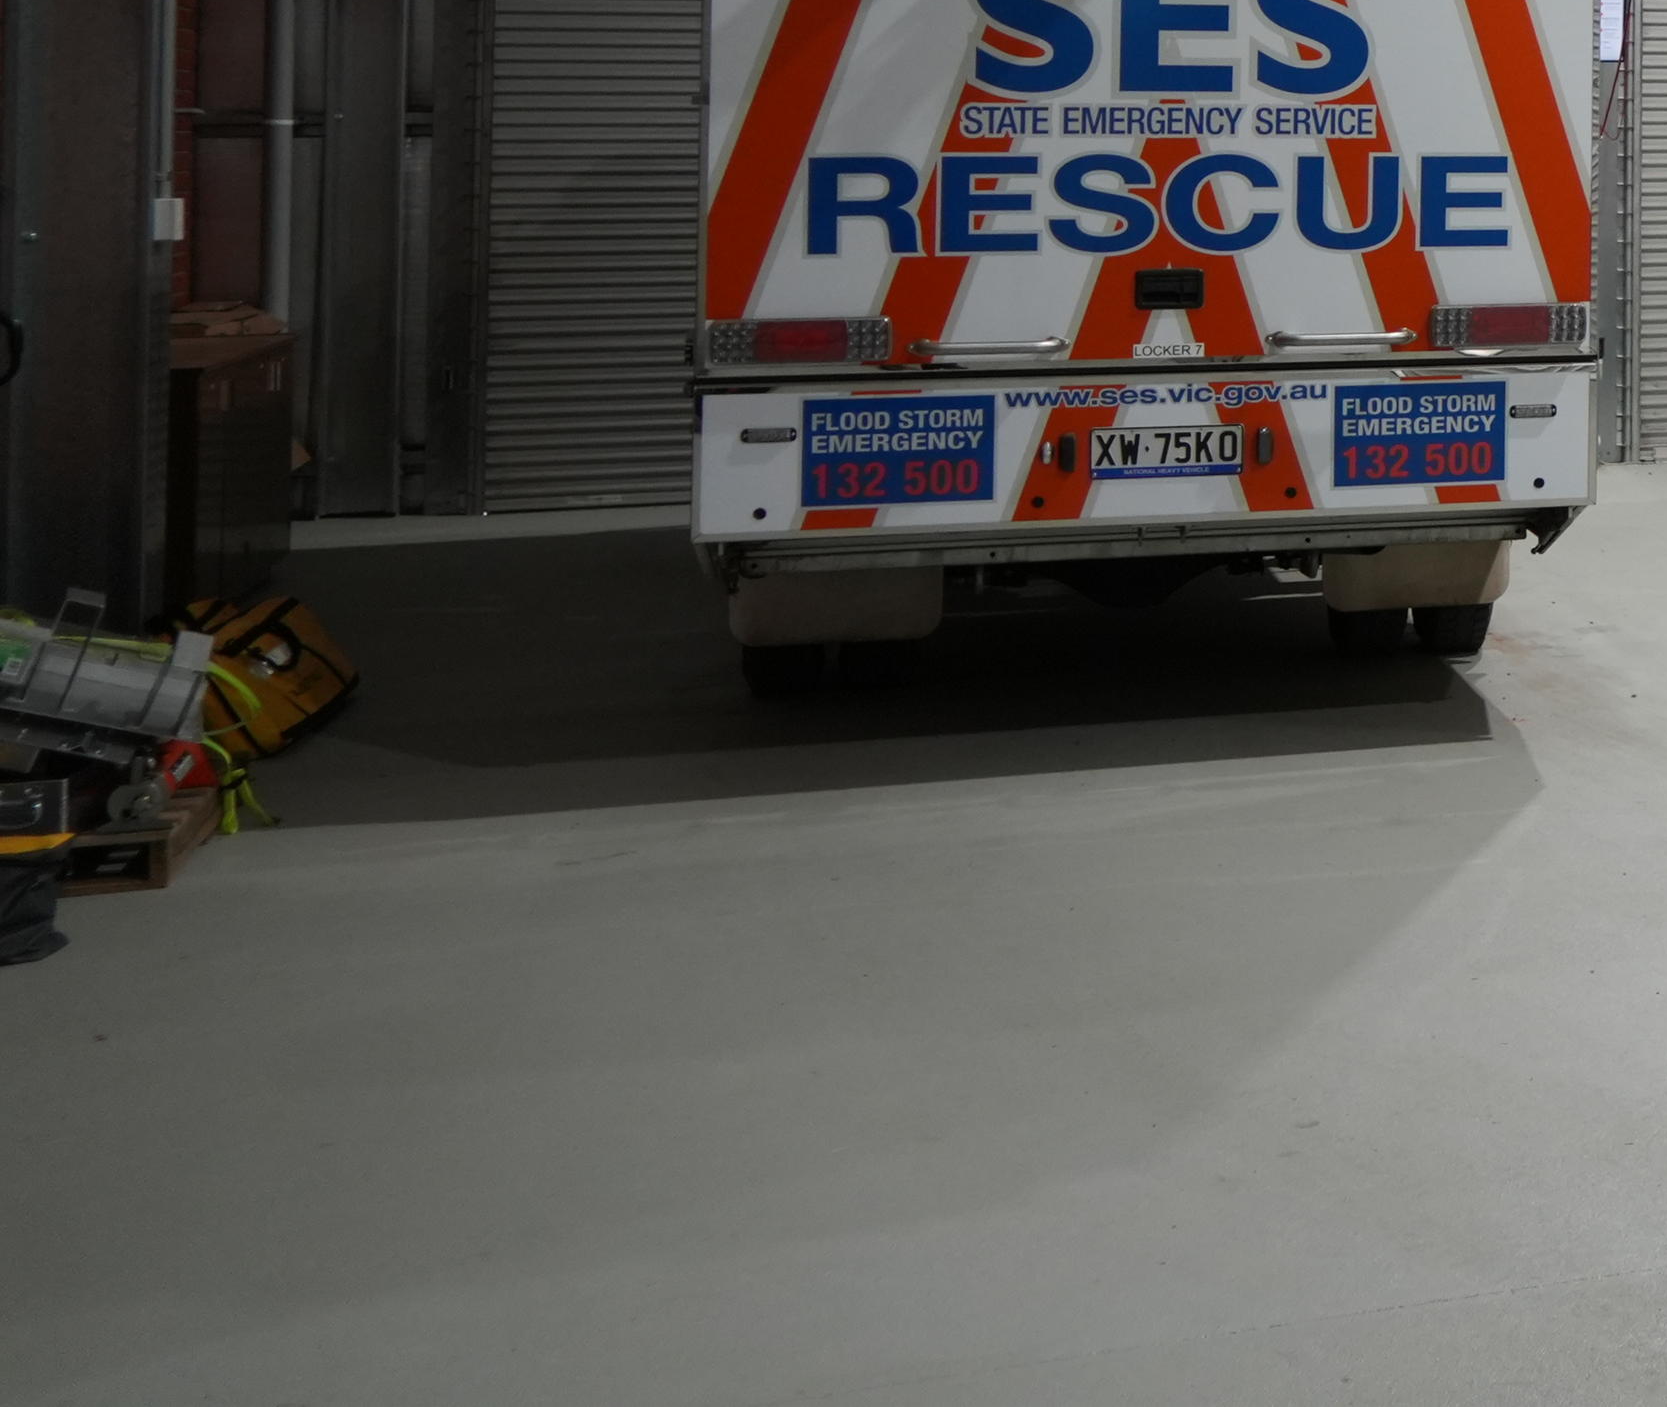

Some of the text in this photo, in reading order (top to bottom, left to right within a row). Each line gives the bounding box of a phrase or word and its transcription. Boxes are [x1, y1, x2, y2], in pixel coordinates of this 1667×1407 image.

[963, 105, 1374, 136] STATE EMERGENCY SERVICE
[808, 154, 1510, 256] RESCUE
[1134, 344, 1203, 357] LOCKER 7
[1004, 383, 1327, 408] www.ses.vic.gov.au
[1342, 394, 1496, 416] FLOOD STORM
[811, 409, 984, 431] FLOOD STORM
[1342, 415, 1497, 437] EMERGENCY
[811, 431, 984, 454] EMERGENCY
[1343, 442, 1493, 479] 132 500
[812, 458, 981, 498] 132 500
